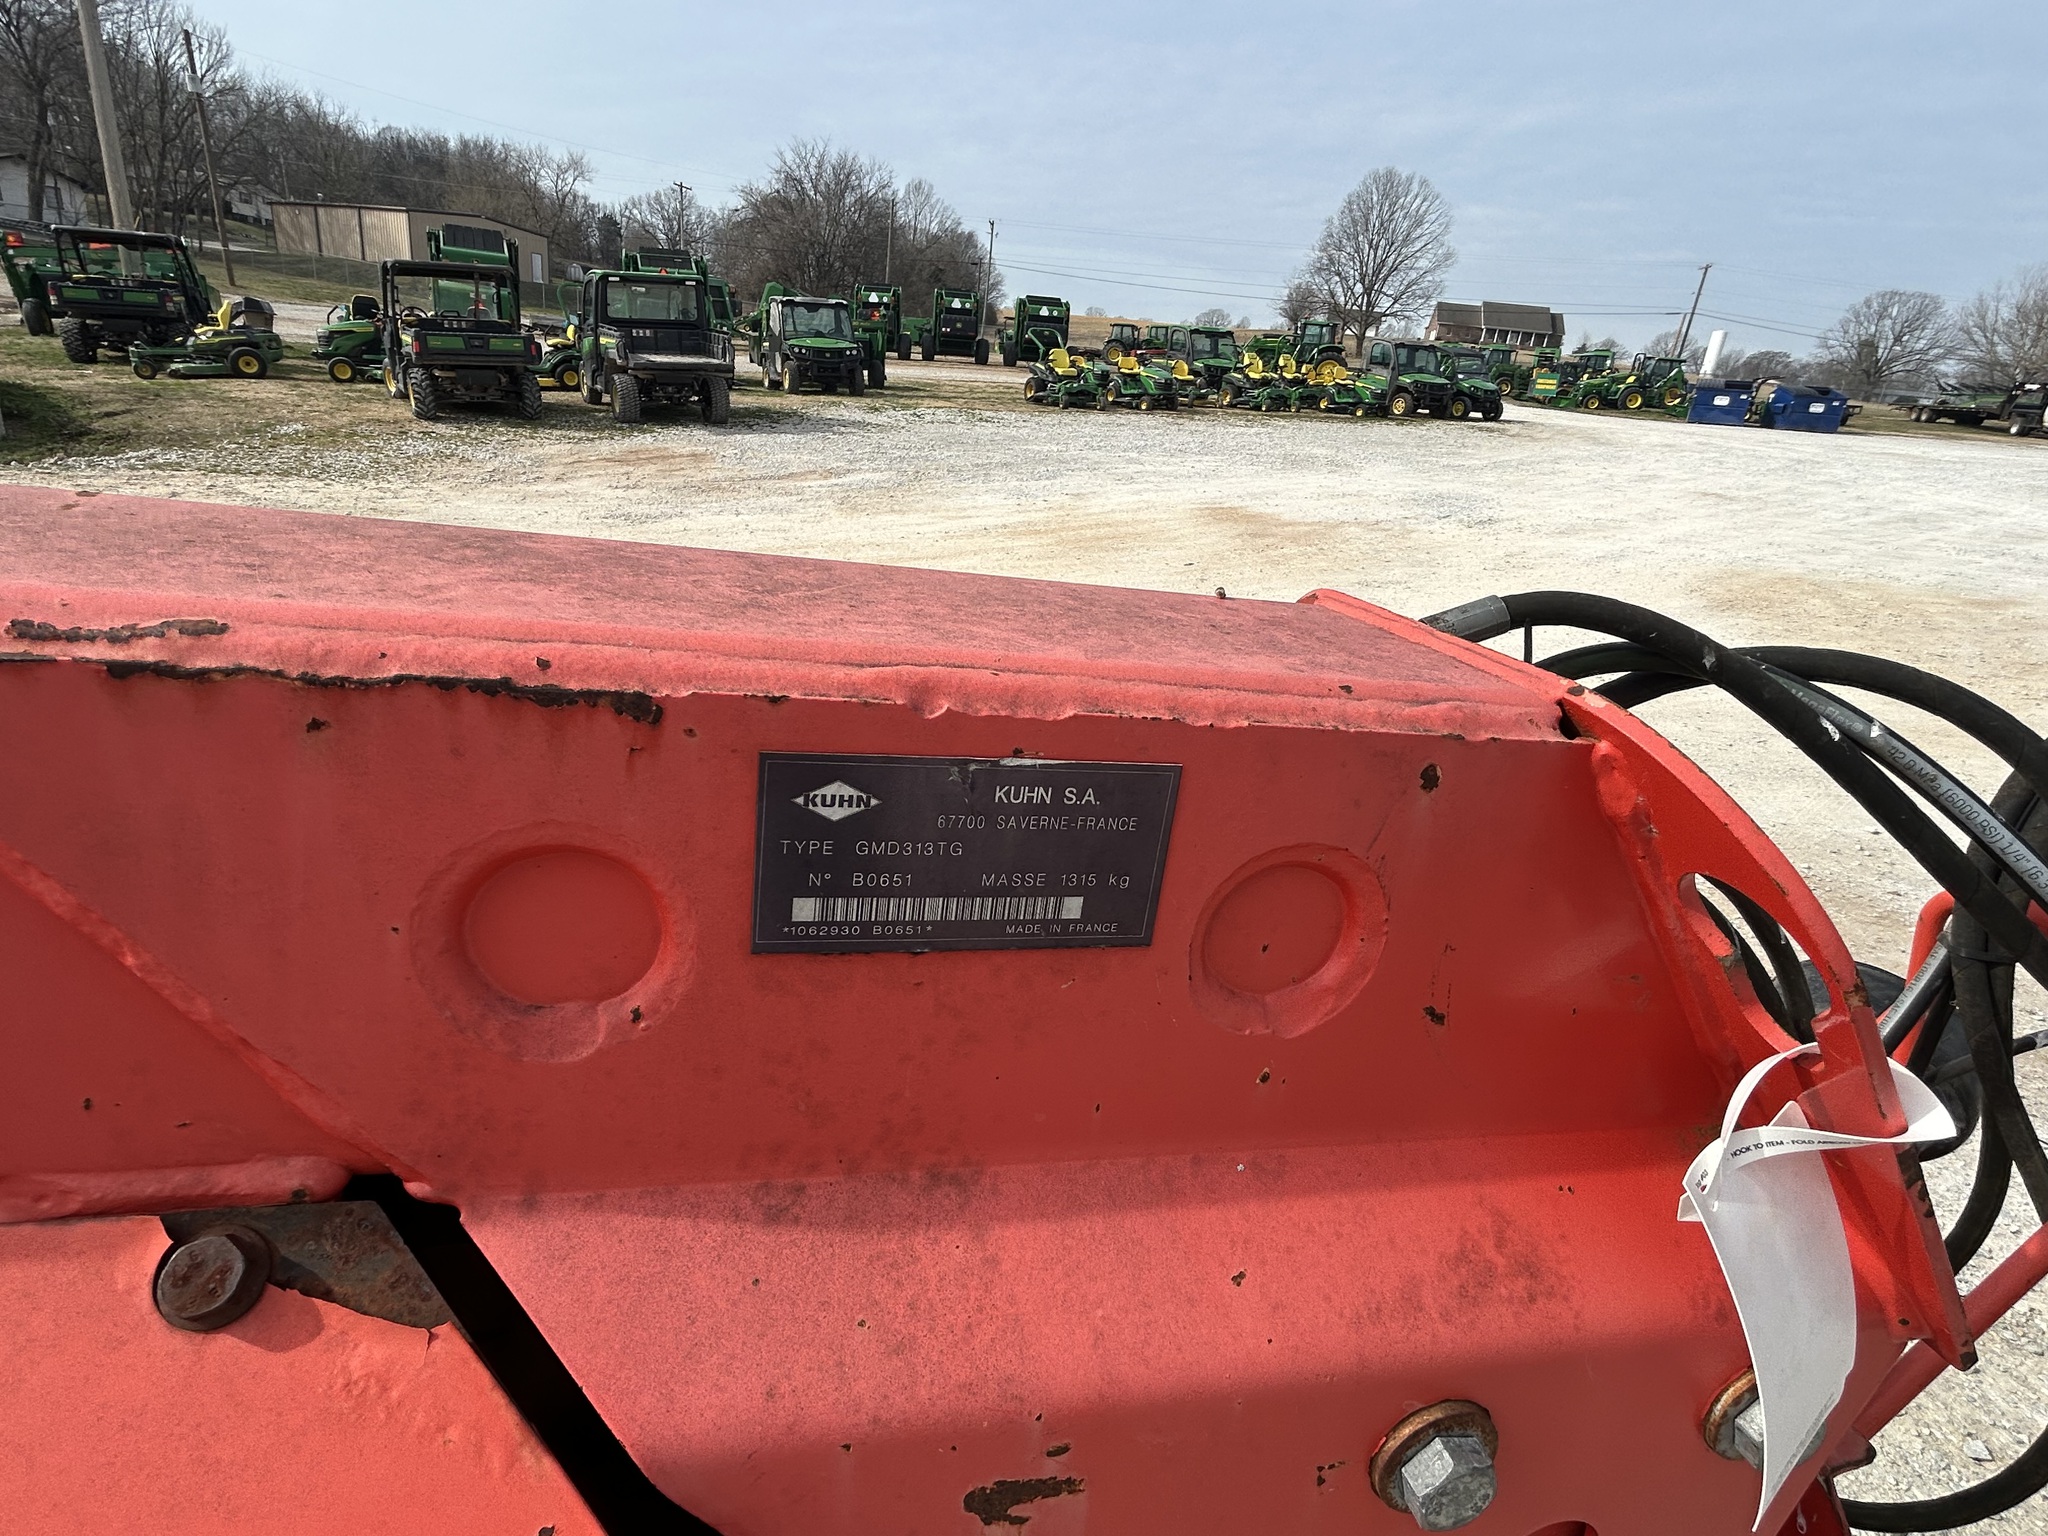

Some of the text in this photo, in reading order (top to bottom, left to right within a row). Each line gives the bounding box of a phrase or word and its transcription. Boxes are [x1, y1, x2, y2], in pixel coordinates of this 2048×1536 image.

[1915, 768, 1942, 792] MPa
[802, 792, 872, 808] KUHN
[995, 785, 1101, 804] KUHN S.A.
[938, 814, 1139, 832] 67700 SAVERNE-FRANCE
[780, 840, 964, 856] TYPE GMD313TG
[852, 873, 913, 887] B0651
[981, 873, 1048, 887] MASSE
[1061, 873, 1098, 887] 1315
[1108, 873, 1132, 889] kg
[1005, 924, 1042, 935] MADE
[1049, 924, 1062, 934] IN
[1068, 923, 1119, 934] FRANCE
[1730, 1145, 1753, 1159] HOOK
[1753, 1142, 1764, 1151] TO
[1765, 1139, 1784, 1148] ITEM
